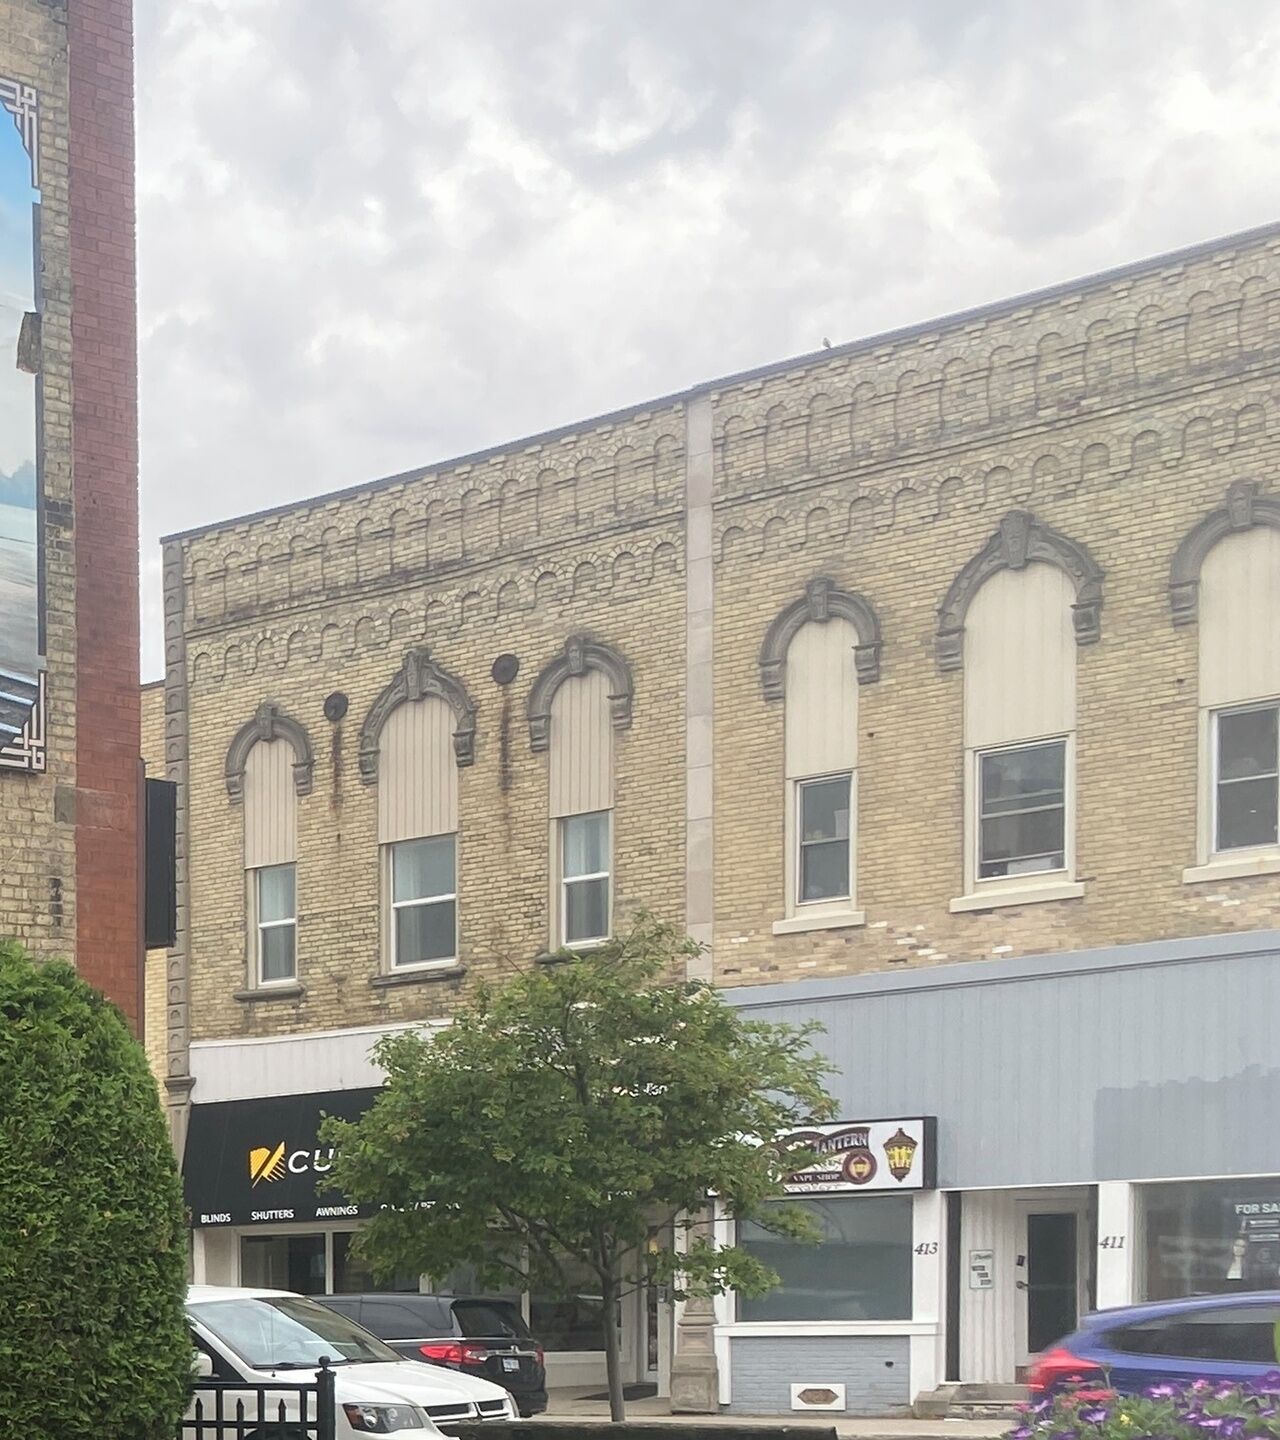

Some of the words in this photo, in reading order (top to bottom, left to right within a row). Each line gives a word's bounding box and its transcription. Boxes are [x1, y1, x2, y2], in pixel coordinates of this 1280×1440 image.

[200, 1213, 231, 1224] BLINDS
[251, 1209, 294, 1221] SHUTTERS
[315, 1205, 358, 1217] AWNINGS
[1234, 1203, 1260, 1214] FOR
[1262, 1202, 1280, 1213] SA
[914, 1242, 938, 1255] 413
[1099, 1236, 1125, 1249] 411
